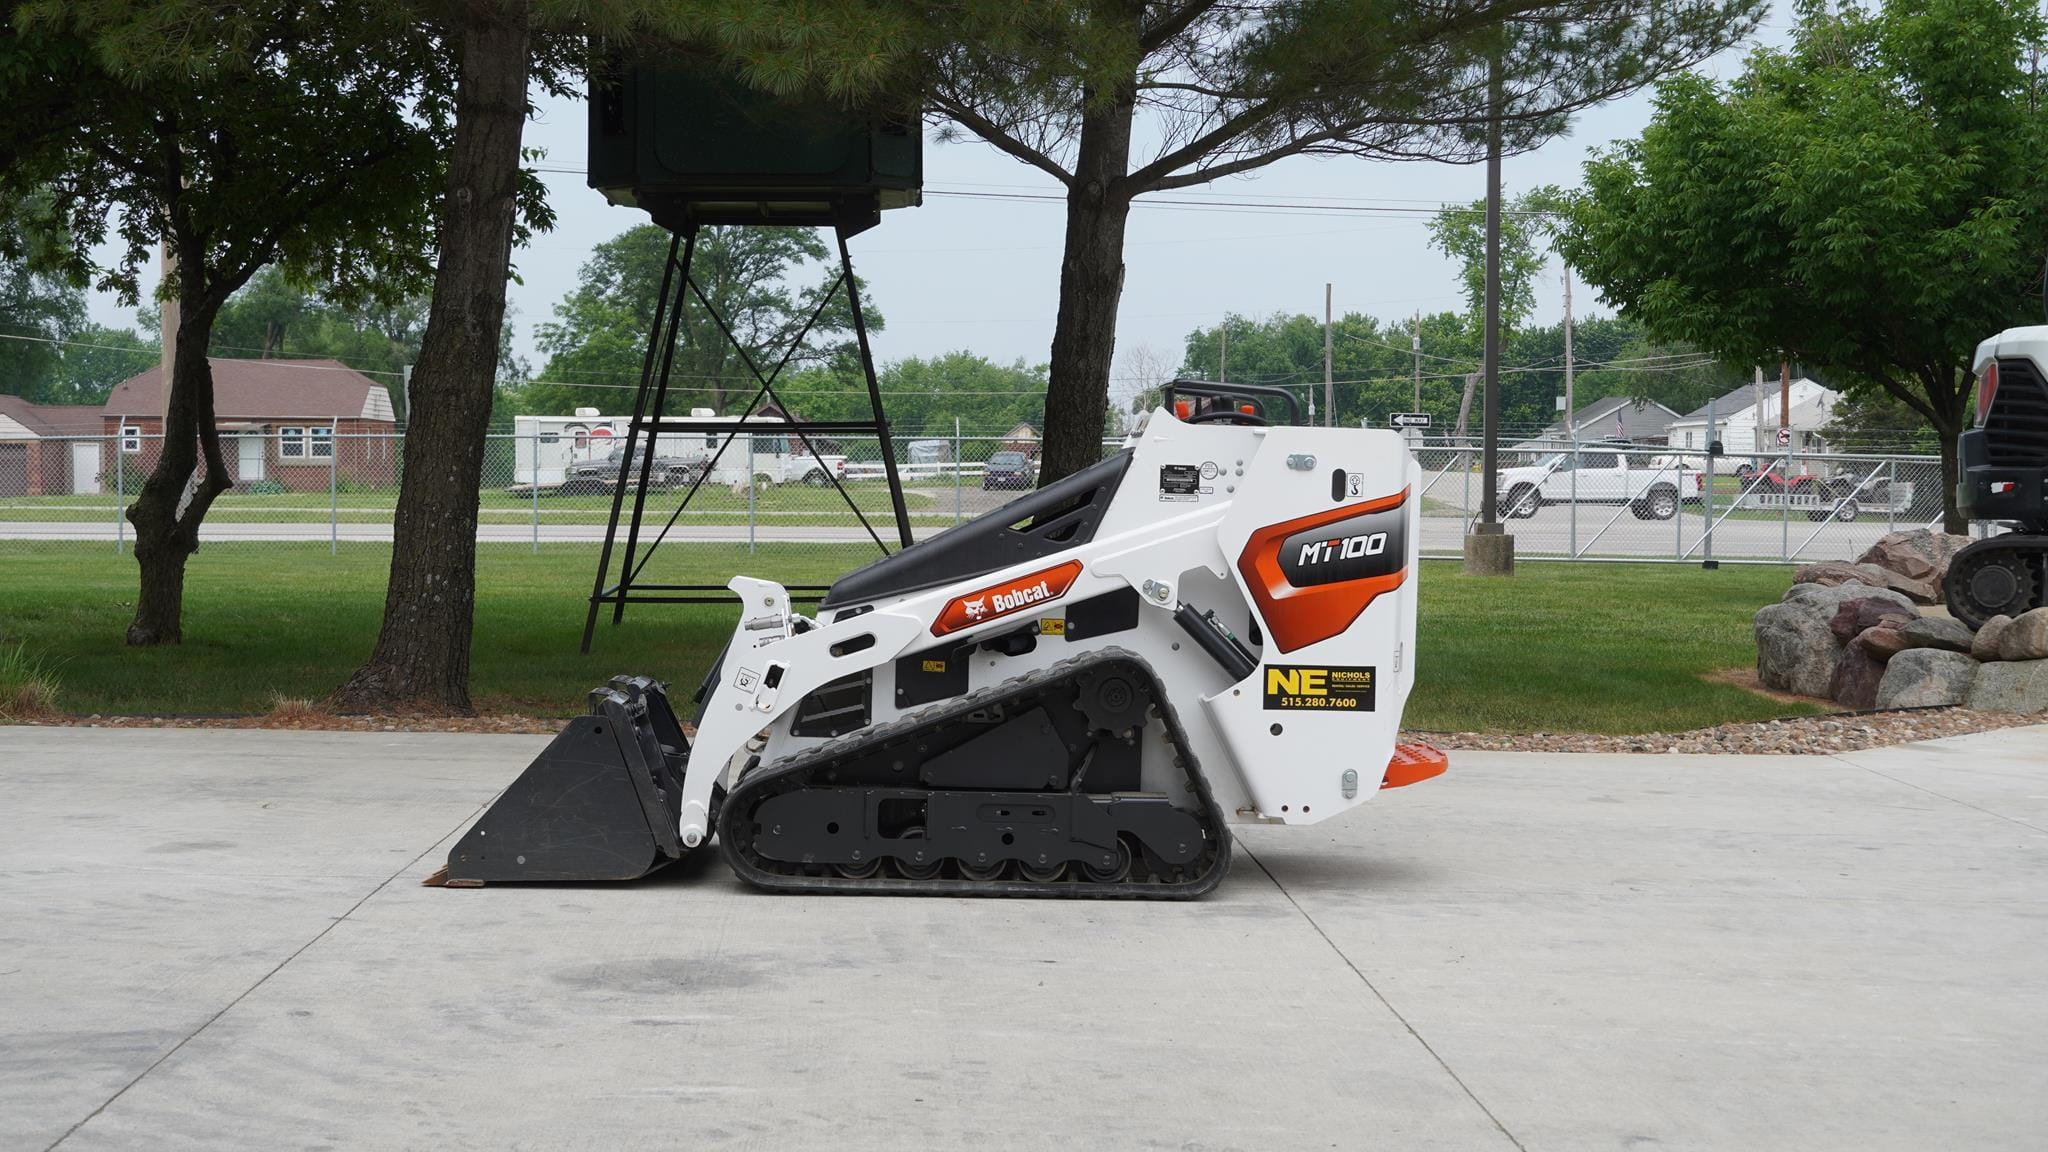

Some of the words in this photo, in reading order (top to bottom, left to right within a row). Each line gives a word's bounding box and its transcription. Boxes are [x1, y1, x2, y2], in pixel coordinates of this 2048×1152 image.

[1298, 532, 1388, 566] MT100
[991, 580, 1050, 613] Bobcat
[1267, 669, 1328, 695] NE
[1331, 671, 1371, 679] NICHOLS
[1281, 697, 1357, 707] 515.280.7600
